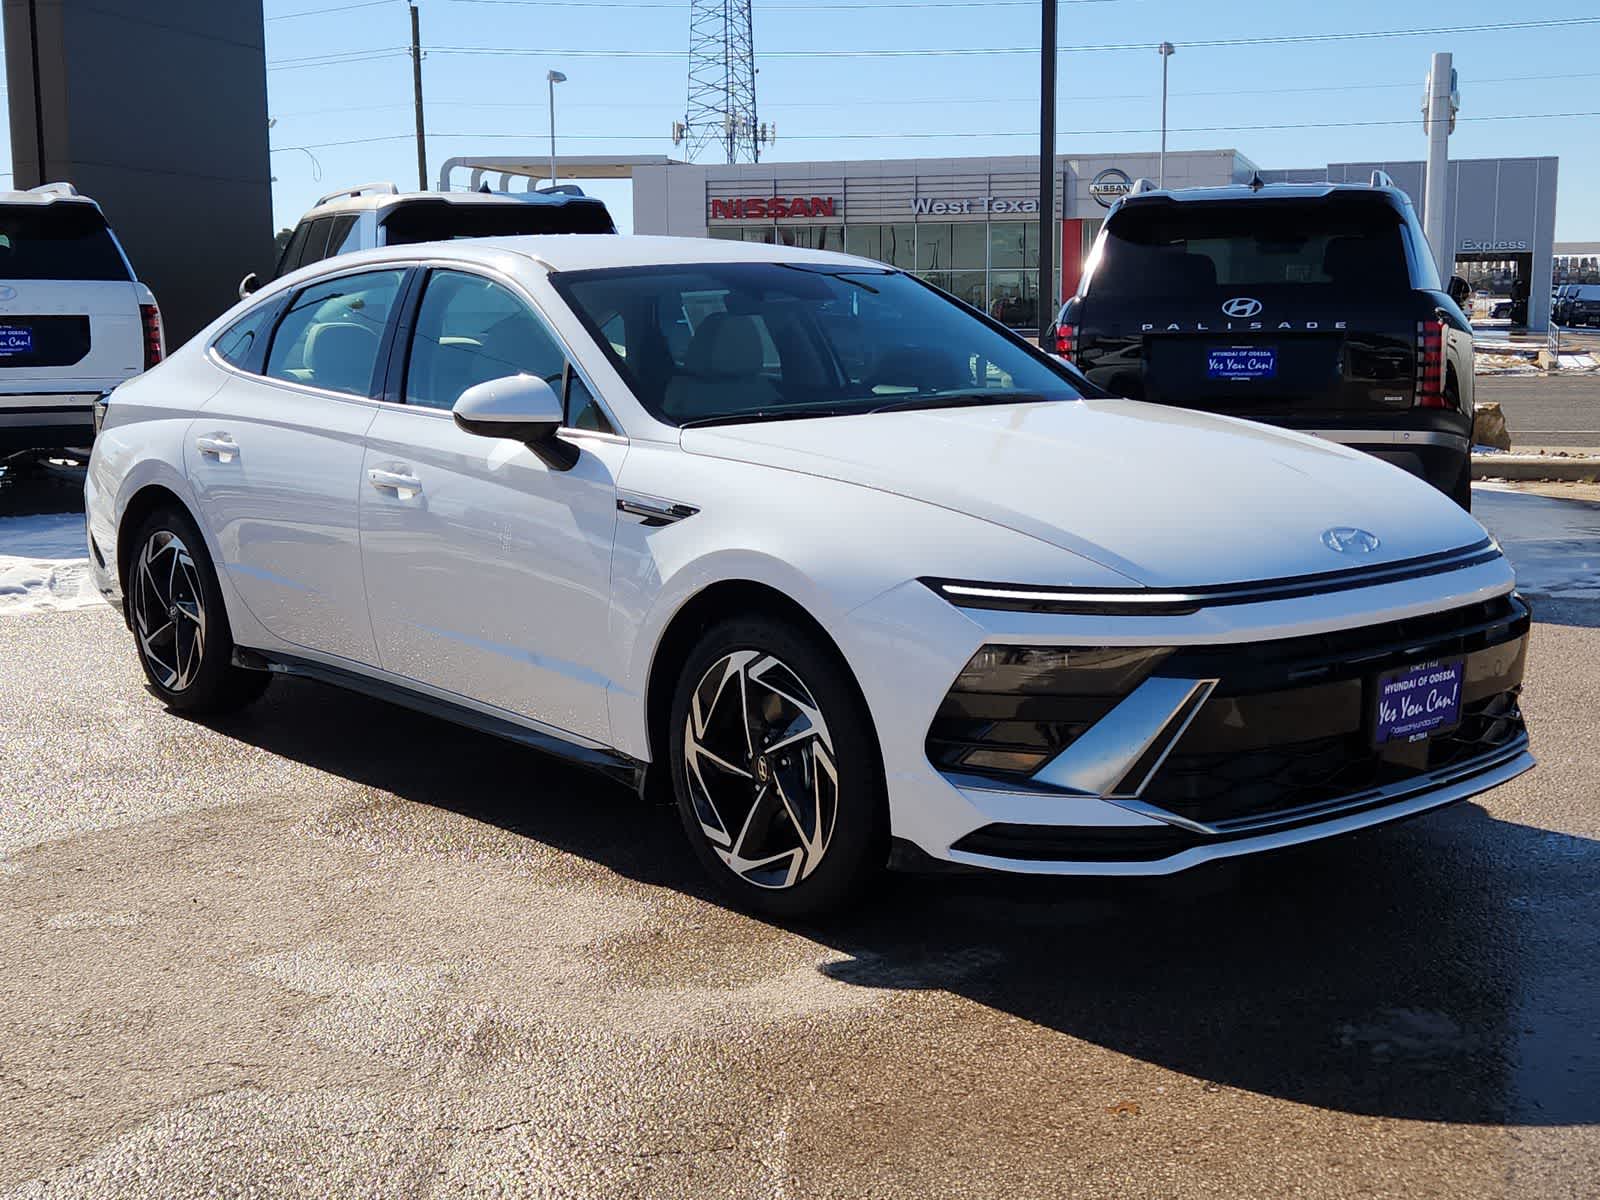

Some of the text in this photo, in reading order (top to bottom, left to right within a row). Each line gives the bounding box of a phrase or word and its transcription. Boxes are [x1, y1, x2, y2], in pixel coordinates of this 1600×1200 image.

[1093, 184, 1130, 193] NISSAN
[711, 196, 833, 219] NISSAN
[910, 196, 1040, 215] West Texa
[1462, 239, 1527, 252] Express
[1142, 321, 1347, 331] PALISADE
[1208, 358, 1273, 370] Yes You Can!
[1385, 670, 1455, 694] HYUNDAI OF ODESSA
[1379, 682, 1458, 725] Yes You Can!
